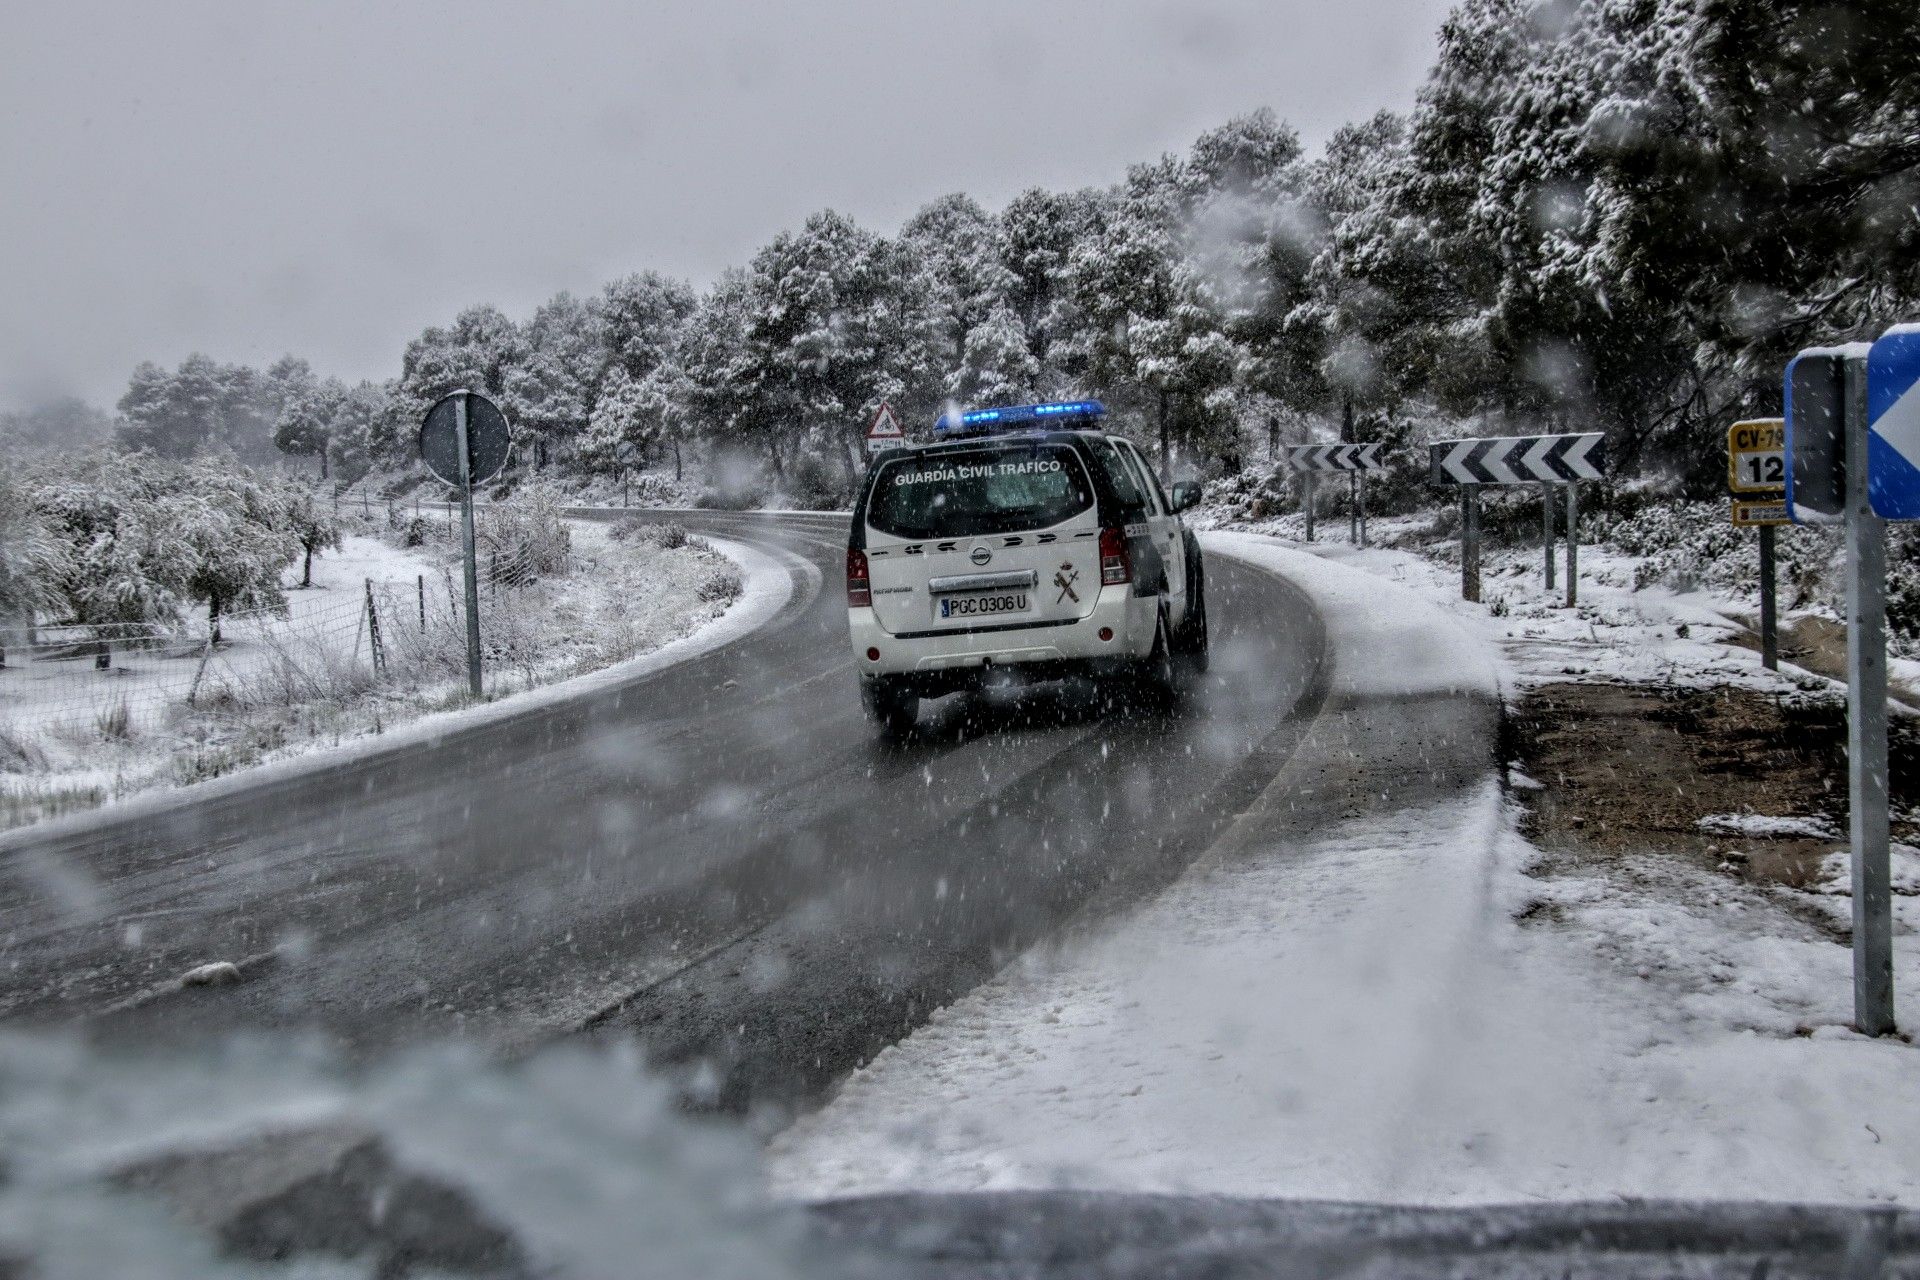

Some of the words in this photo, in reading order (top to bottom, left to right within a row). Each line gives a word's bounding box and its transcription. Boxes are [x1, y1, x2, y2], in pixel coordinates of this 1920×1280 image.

[895, 468, 956, 486] GUARDIA
[959, 465, 996, 479] CIVIL
[998, 460, 1061, 476] TRAFICO
[1748, 456, 1785, 483] 12
[950, 598, 977, 615] PGC
[979, 595, 1015, 613] 0306
[1017, 594, 1026, 609] U
